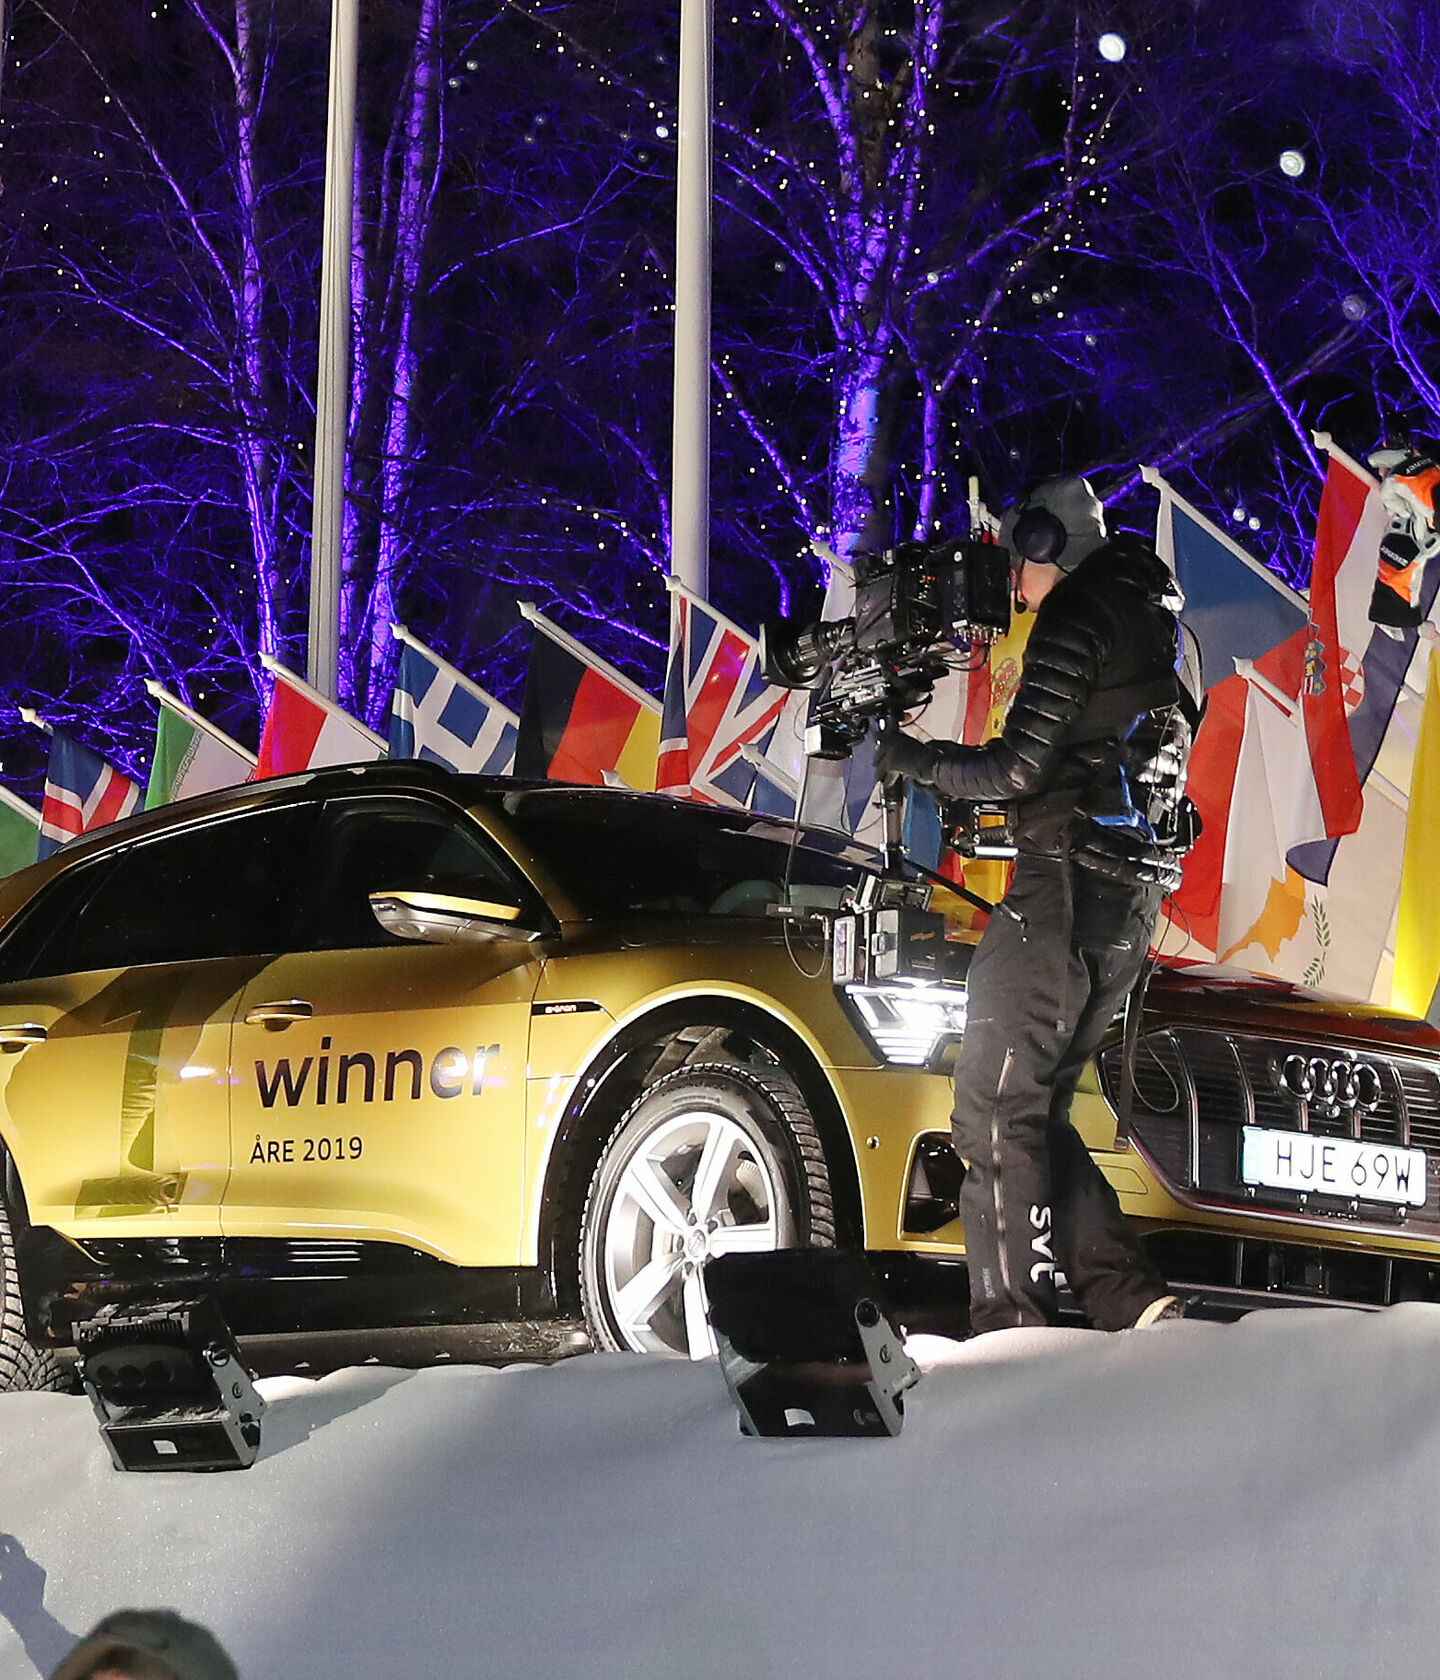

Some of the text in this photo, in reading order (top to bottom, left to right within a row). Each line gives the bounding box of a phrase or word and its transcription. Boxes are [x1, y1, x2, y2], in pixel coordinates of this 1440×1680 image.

[254, 1036, 501, 1108] winner
[250, 1134, 363, 1164] ÅRE 2019
[1276, 1139, 1411, 1193] HJE 69W
